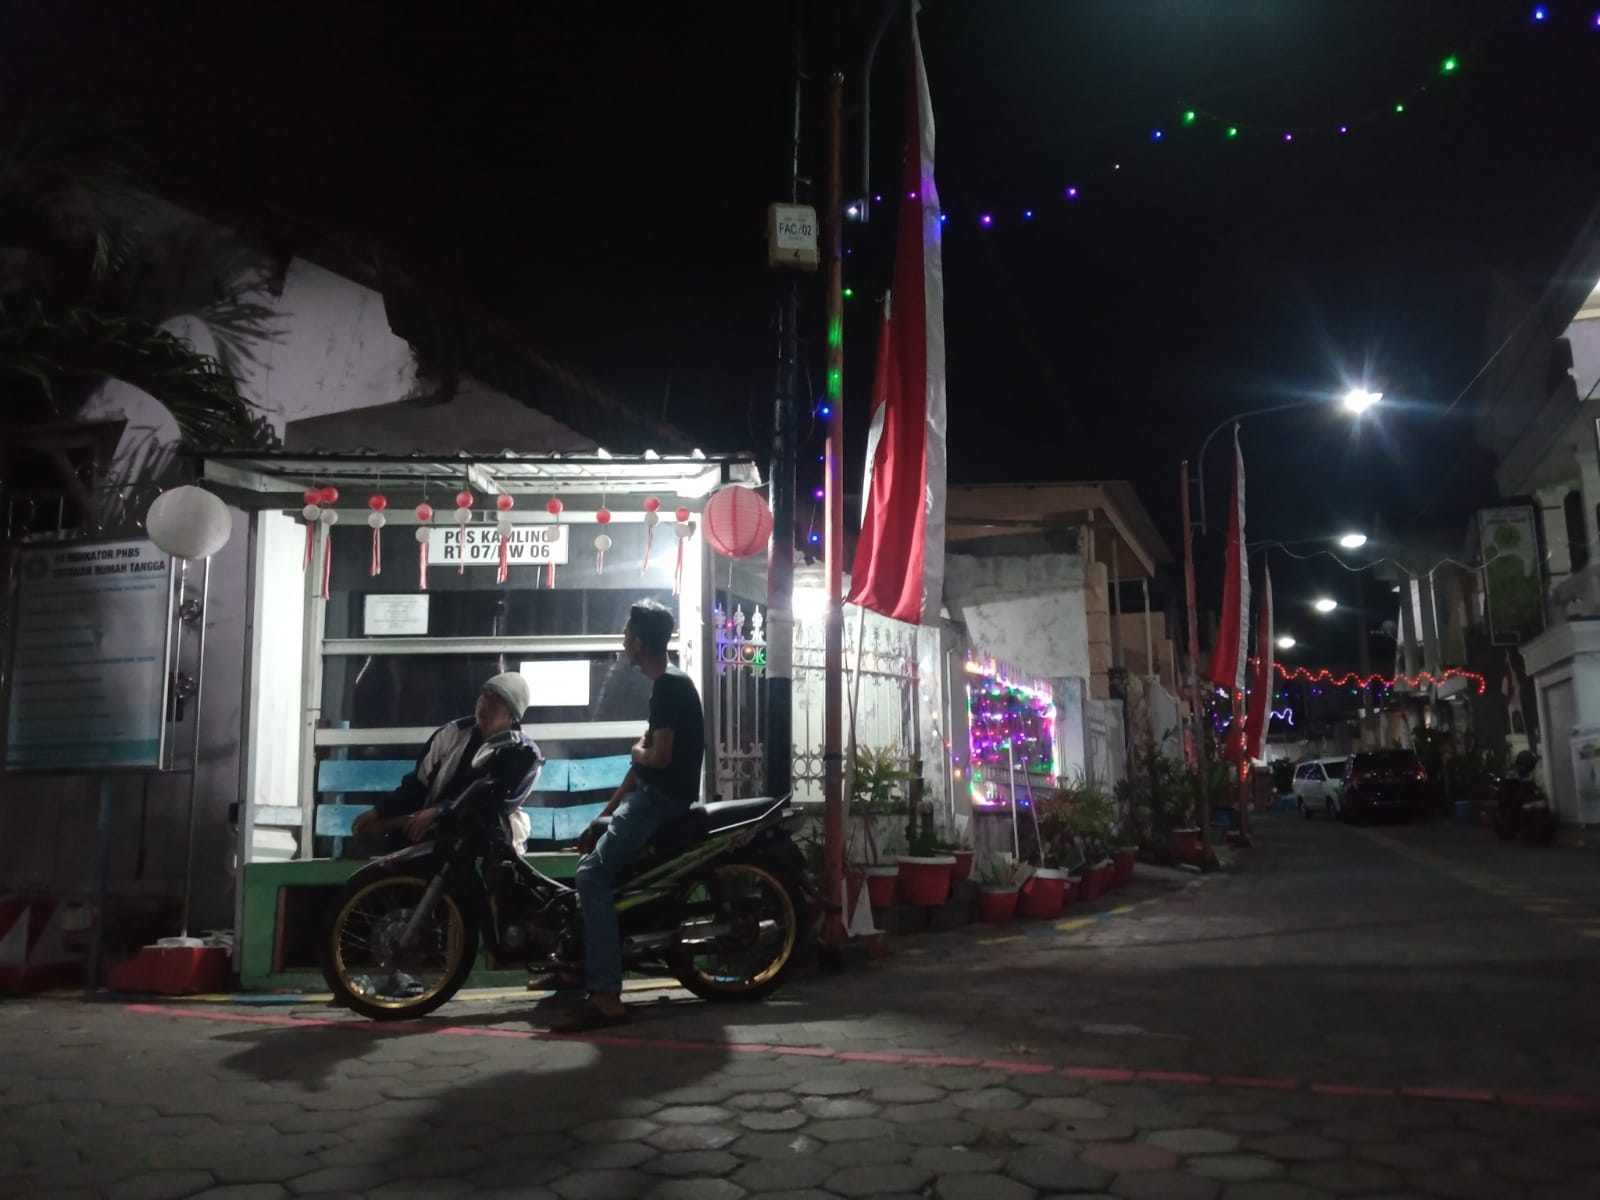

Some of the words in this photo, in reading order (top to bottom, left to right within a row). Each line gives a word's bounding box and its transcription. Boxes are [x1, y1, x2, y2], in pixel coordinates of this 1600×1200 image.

[779, 223, 812, 236] FAC/02
[116, 547, 140, 559] PHBS
[444, 545, 463, 559] RT
[530, 544, 550, 558] 06
[130, 560, 165, 573] TANGGA
